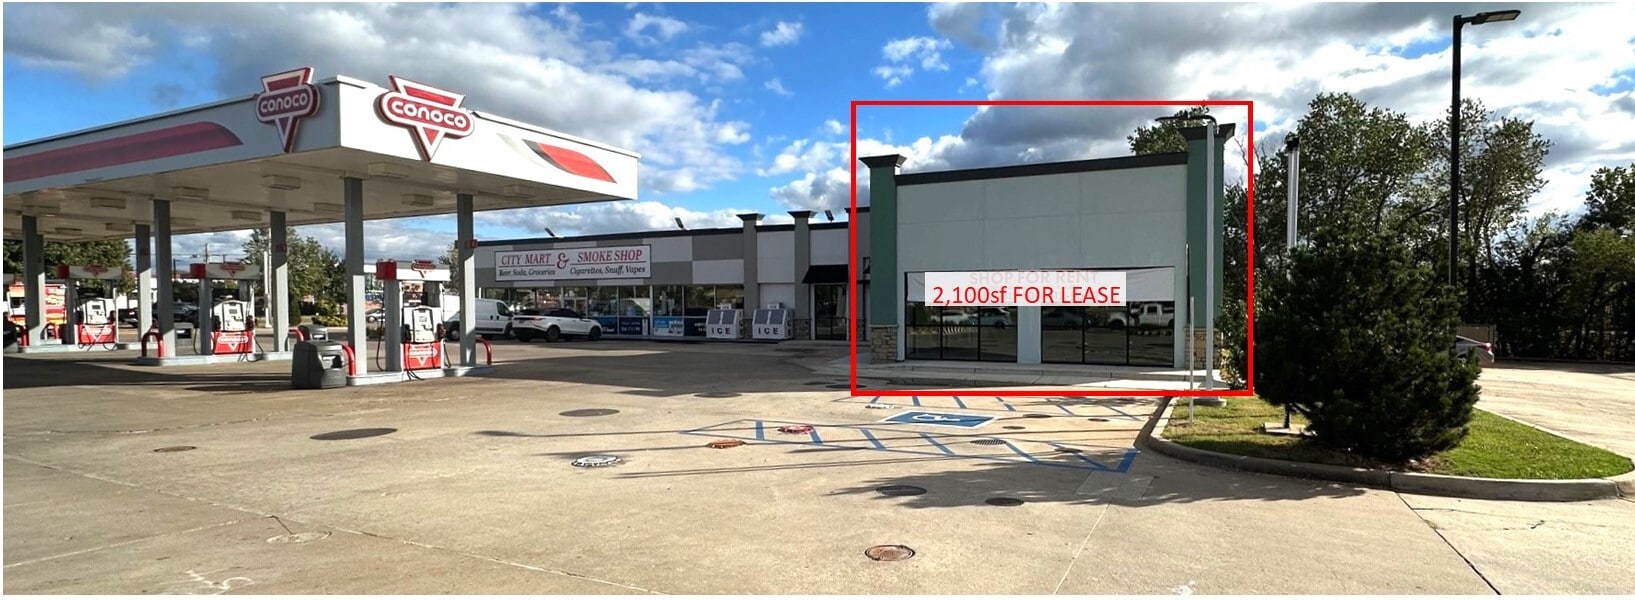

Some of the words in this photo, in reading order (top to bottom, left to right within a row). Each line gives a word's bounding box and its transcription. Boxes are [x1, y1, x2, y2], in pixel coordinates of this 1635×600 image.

[501, 254, 521, 266] CITY
[525, 253, 551, 264] MART
[556, 252, 570, 269] &
[577, 250, 612, 263] SMOKE
[614, 249, 643, 261] SHOP
[528, 268, 556, 276] Groceries
[625, 264, 646, 275] Vapes
[970, 272, 1013, 285] SHOP
[1017, 271, 1051, 283] FOR
[711, 327, 731, 335] ICE
[757, 327, 779, 335] ICE
